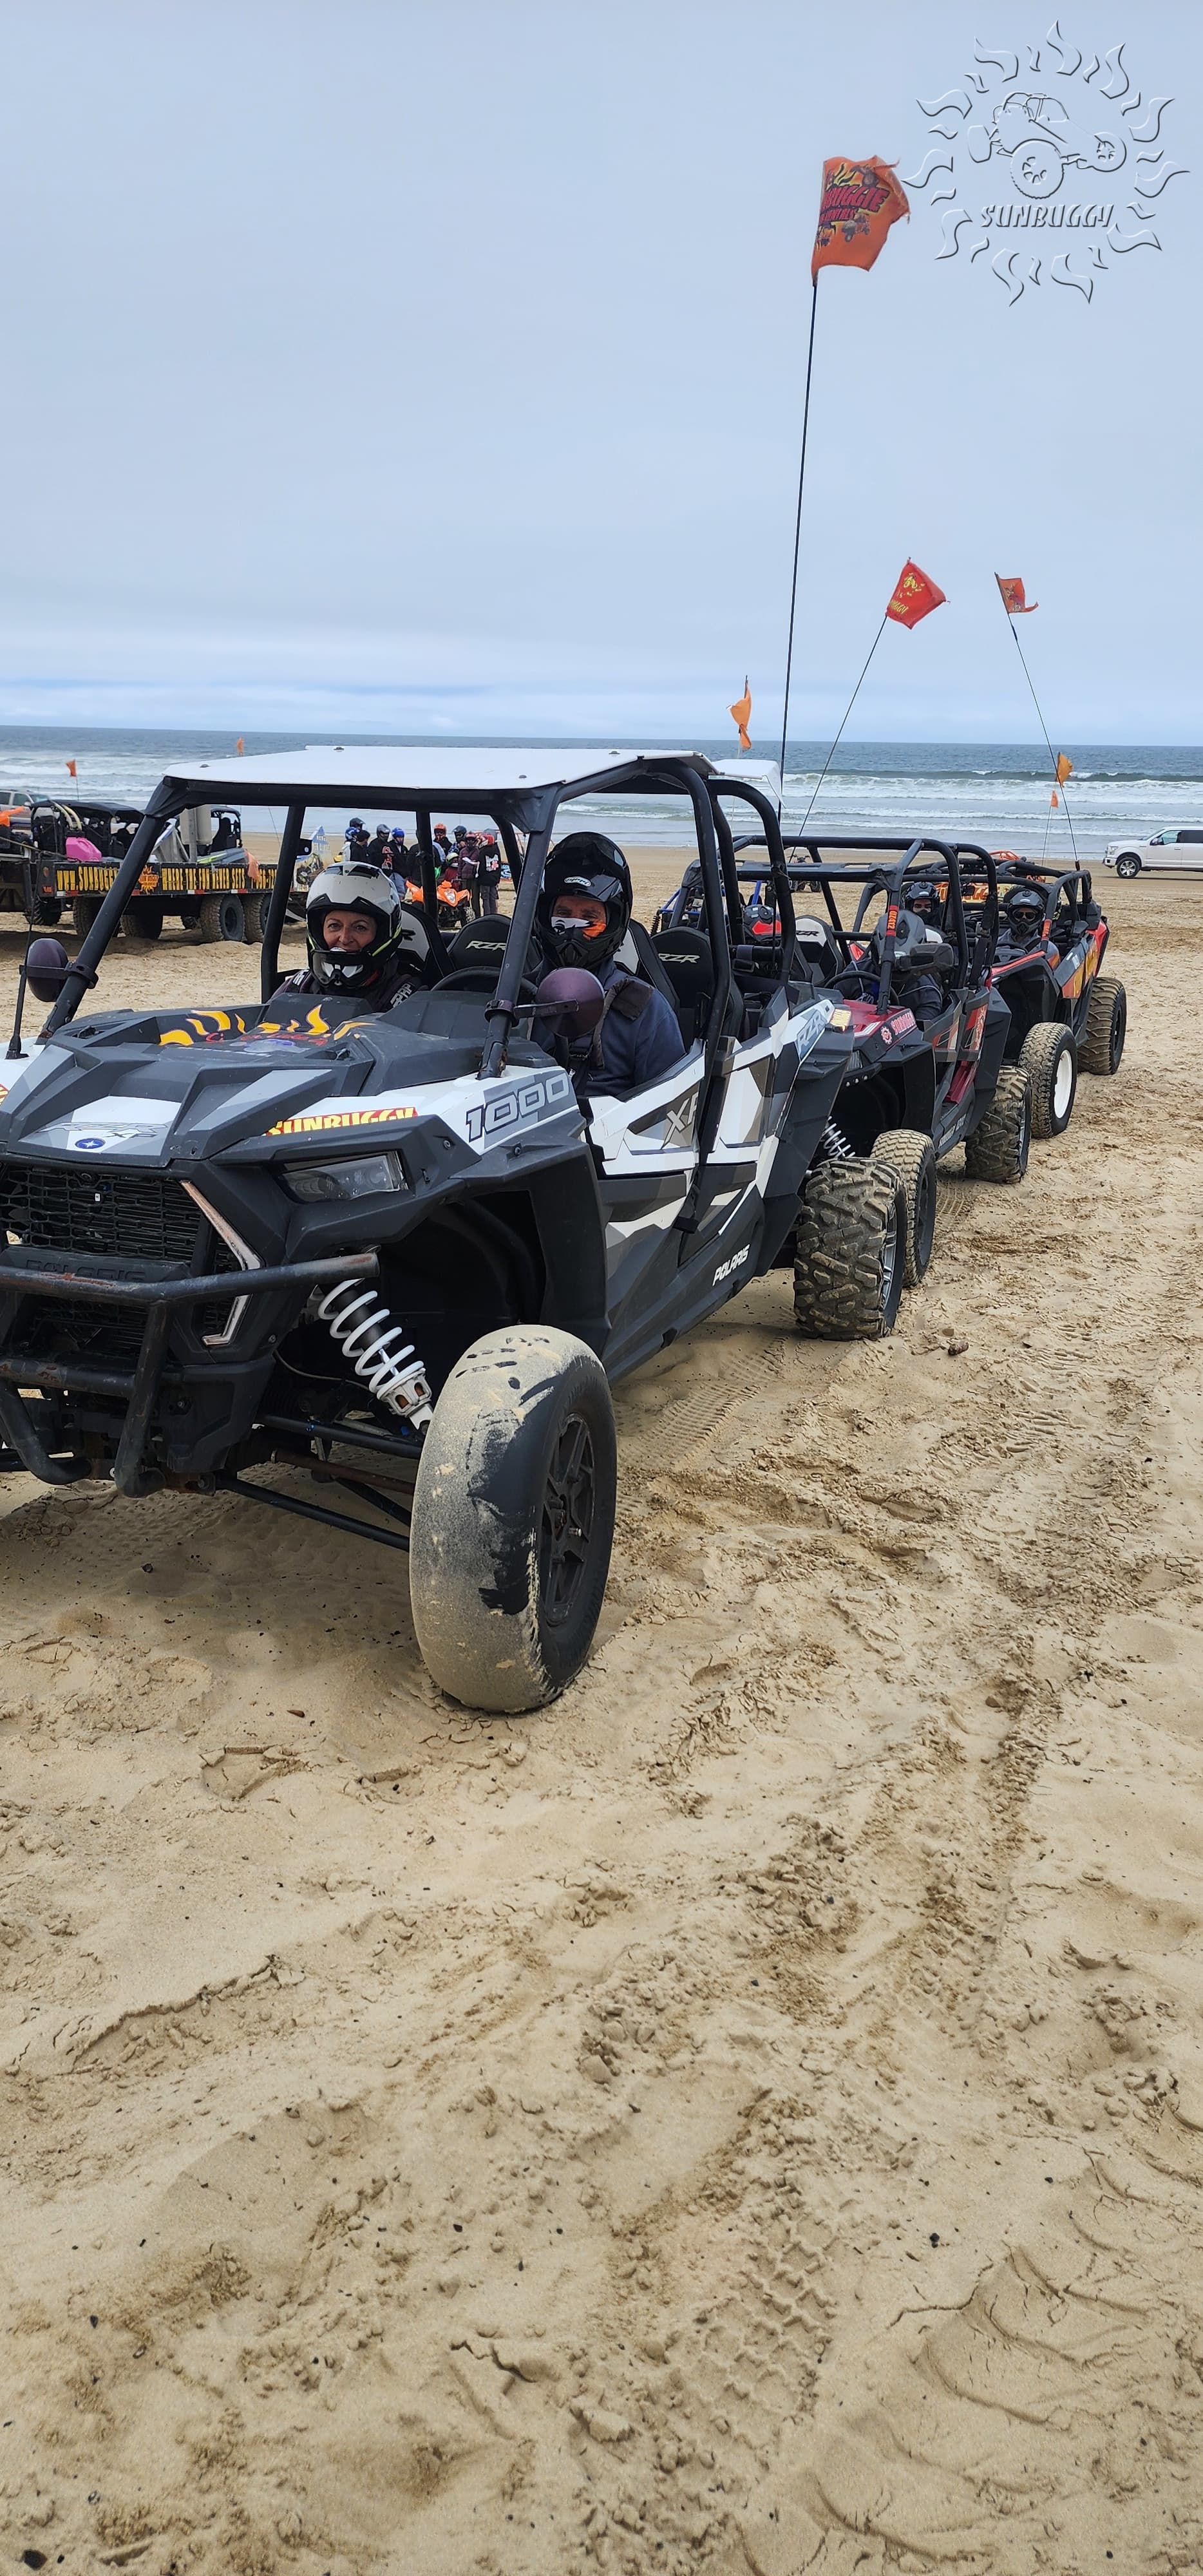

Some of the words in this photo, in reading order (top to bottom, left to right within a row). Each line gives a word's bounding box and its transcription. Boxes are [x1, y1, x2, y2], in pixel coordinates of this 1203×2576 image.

[162, 868, 184, 891] WHERE
[185, 868, 196, 889] THE
[198, 868, 210, 889] FUN
[232, 868, 245, 889] SETS
[465, 940, 507, 951] RZR
[658, 953, 701, 963] RZR
[466, 1073, 569, 1142] 1000
[712, 1244, 750, 1287] POLARIS
